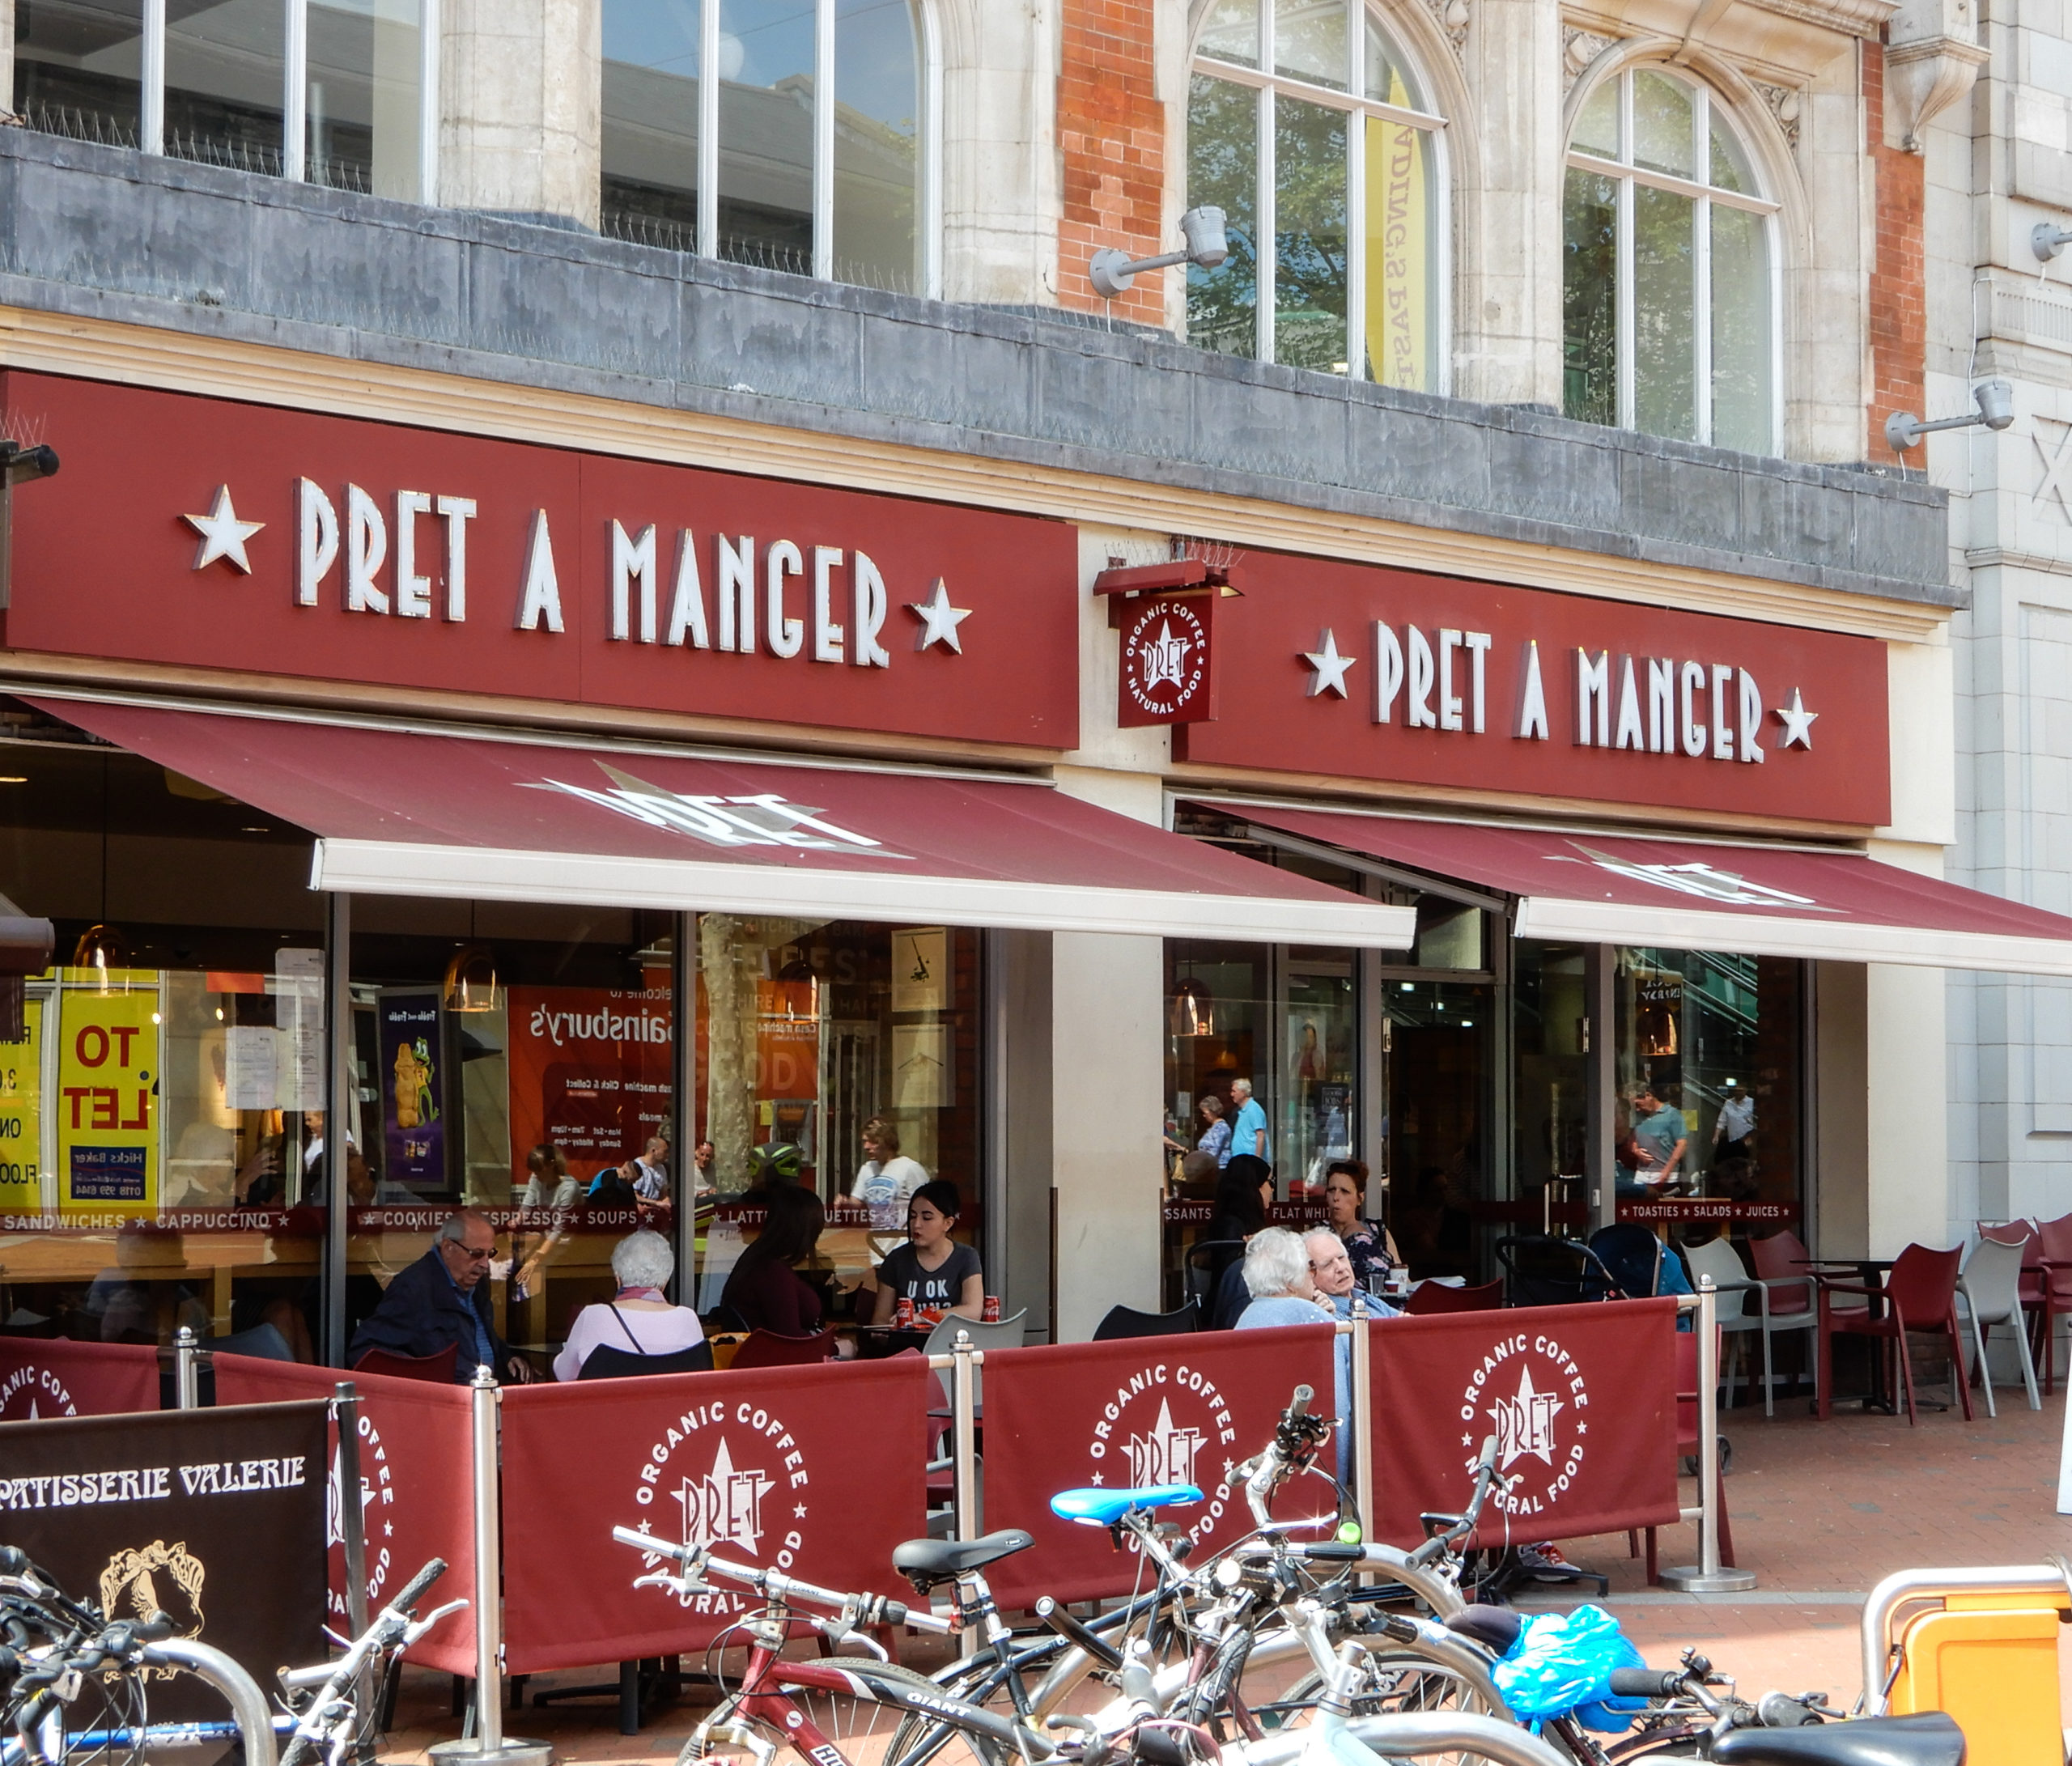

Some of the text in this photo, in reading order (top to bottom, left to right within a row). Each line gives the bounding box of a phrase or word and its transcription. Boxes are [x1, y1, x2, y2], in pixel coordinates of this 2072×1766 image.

[295, 476, 890, 669] PRET A MANGER
[1126, 602, 1206, 657] ORGANIC COFFEE
[1144, 636, 1188, 681] PRET
[1127, 669, 1202, 715] NATURAL FOOD
[1372, 619, 1764, 764] PRET A MANGER
[4, 1213, 271, 1230] SANDWICHES CAPPUCCINO
[481, 1211, 562, 1226] SPRESSO
[587, 1211, 637, 1225] SOUPS
[728, 1209, 877, 1223] LATT UETTES
[1165, 1207, 1331, 1220] SSANTS FLAT WHIT
[1633, 1205, 1779, 1217] TOASTIES SALADS JUICES
[907, 1279, 949, 1298] U OK
[0, 1365, 78, 1416] ANIC COFF
[1461, 1334, 1588, 1420] ORGANIC COFFEE
[1090, 1364, 1235, 1458] ORGANIC COFFEE
[1496, 1392, 1557, 1456] PRET
[358, 1416, 393, 1505] OFFEE
[636, 1401, 809, 1505] ORGANIC COFFEE
[1131, 1427, 1200, 1492] PRET
[1465, 1445, 1583, 1515] NTURAL FOOD
[0, 1456, 306, 1510] PATISSERIE VALERIE
[682, 1468, 766, 1547] PRET
[1188, 1483, 1231, 1547] FOOD
[366, 1547, 390, 1599] OOD
[906, 1692, 972, 1717] GIANT
